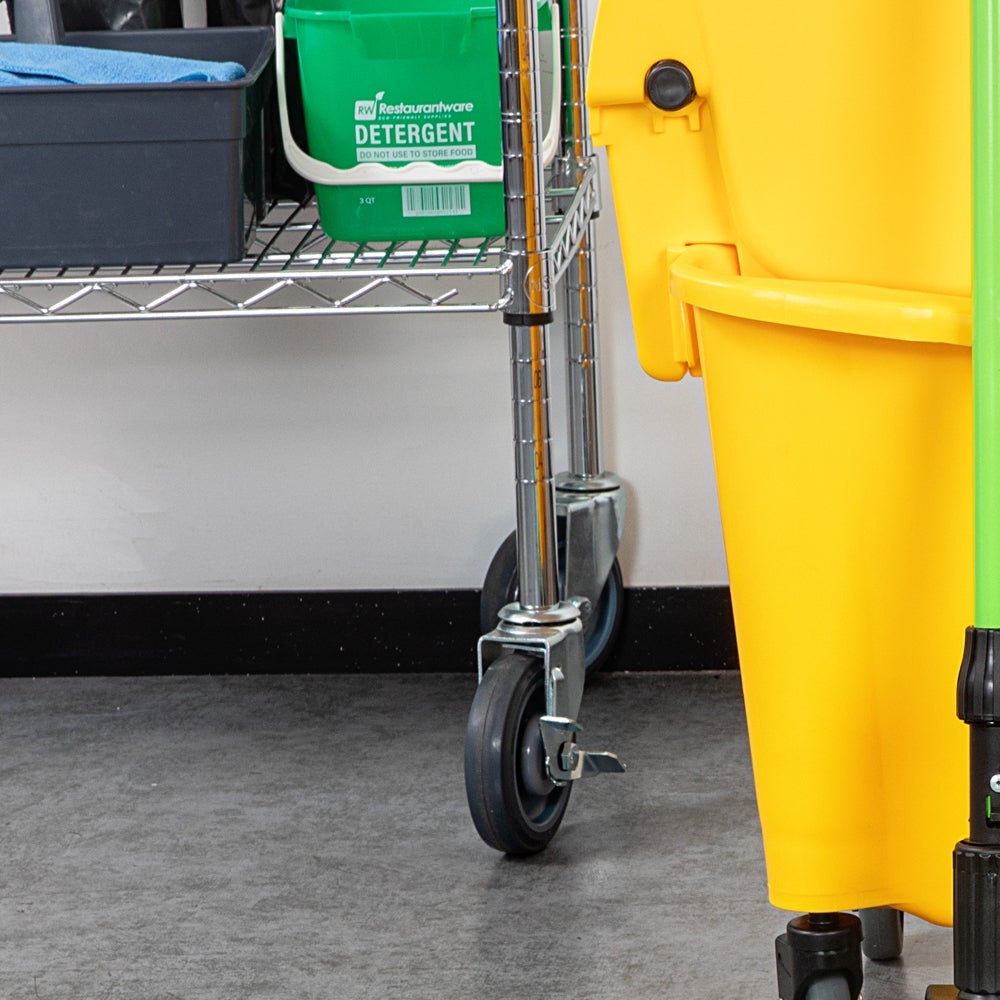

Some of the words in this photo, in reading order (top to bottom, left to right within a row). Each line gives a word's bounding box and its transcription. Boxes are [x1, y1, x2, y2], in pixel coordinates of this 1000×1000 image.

[358, 106, 374, 115] RW
[378, 101, 474, 115] Restaurantware
[355, 121, 476, 145] DETERGENT
[360, 151, 372, 159] DO
[373, 150, 390, 159] NOT
[392, 150, 408, 158] USE
[410, 149, 421, 158] TO
[422, 148, 449, 158] STORE
[450, 147, 474, 157] FOOD
[365, 196, 376, 205] QT
